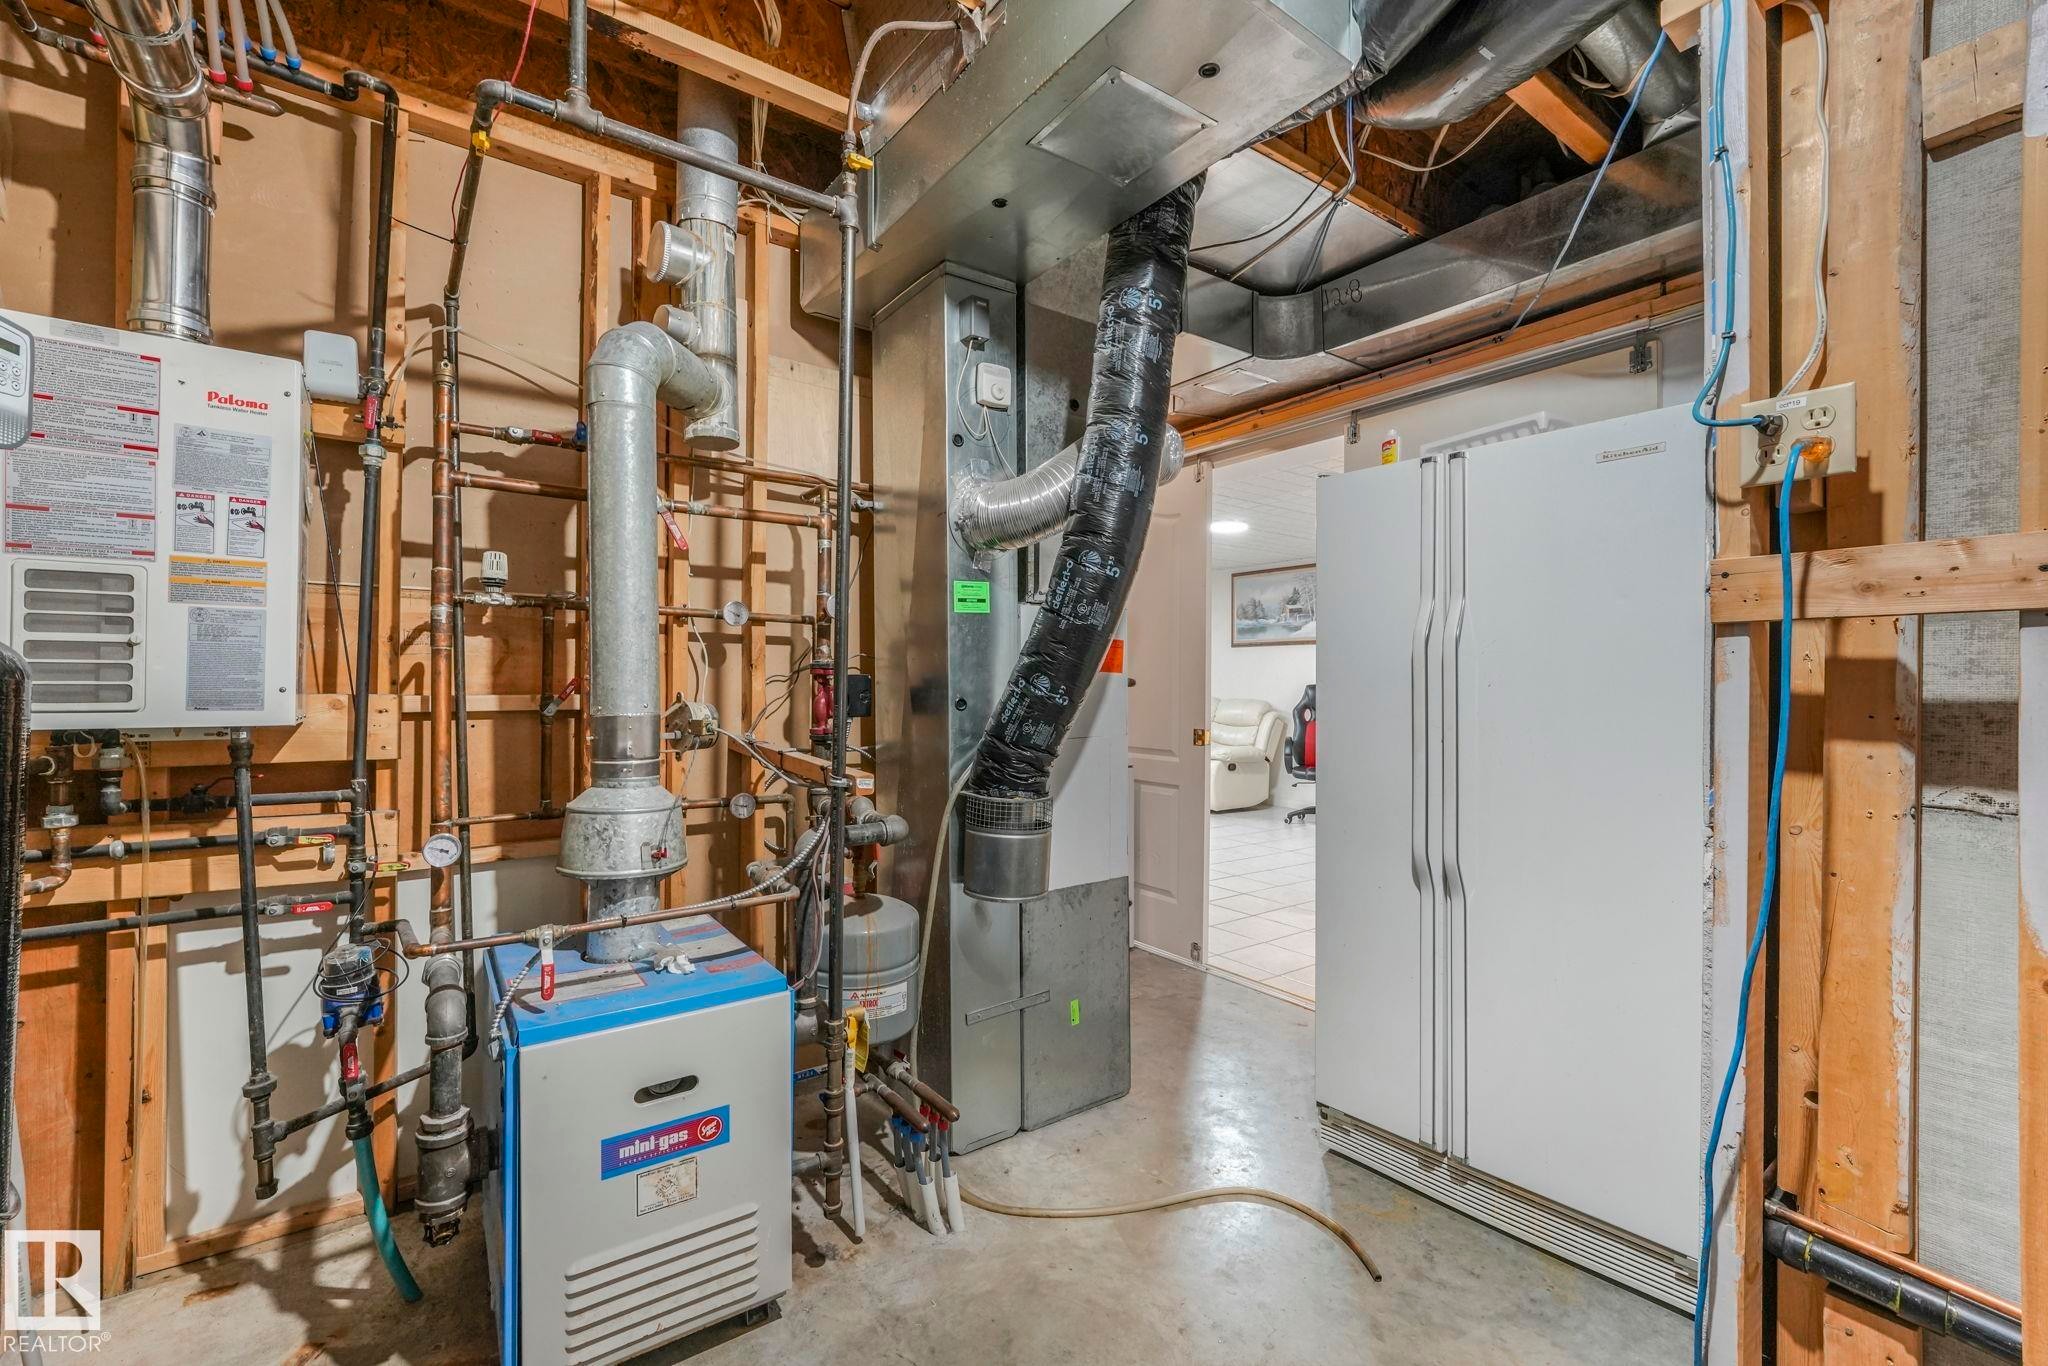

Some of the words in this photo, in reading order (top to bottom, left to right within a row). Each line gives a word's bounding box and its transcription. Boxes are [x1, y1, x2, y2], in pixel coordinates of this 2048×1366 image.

[207, 391, 268, 410] Paloma
[249, 409, 268, 417] Heater
[619, 1130, 688, 1158] mini-gas
